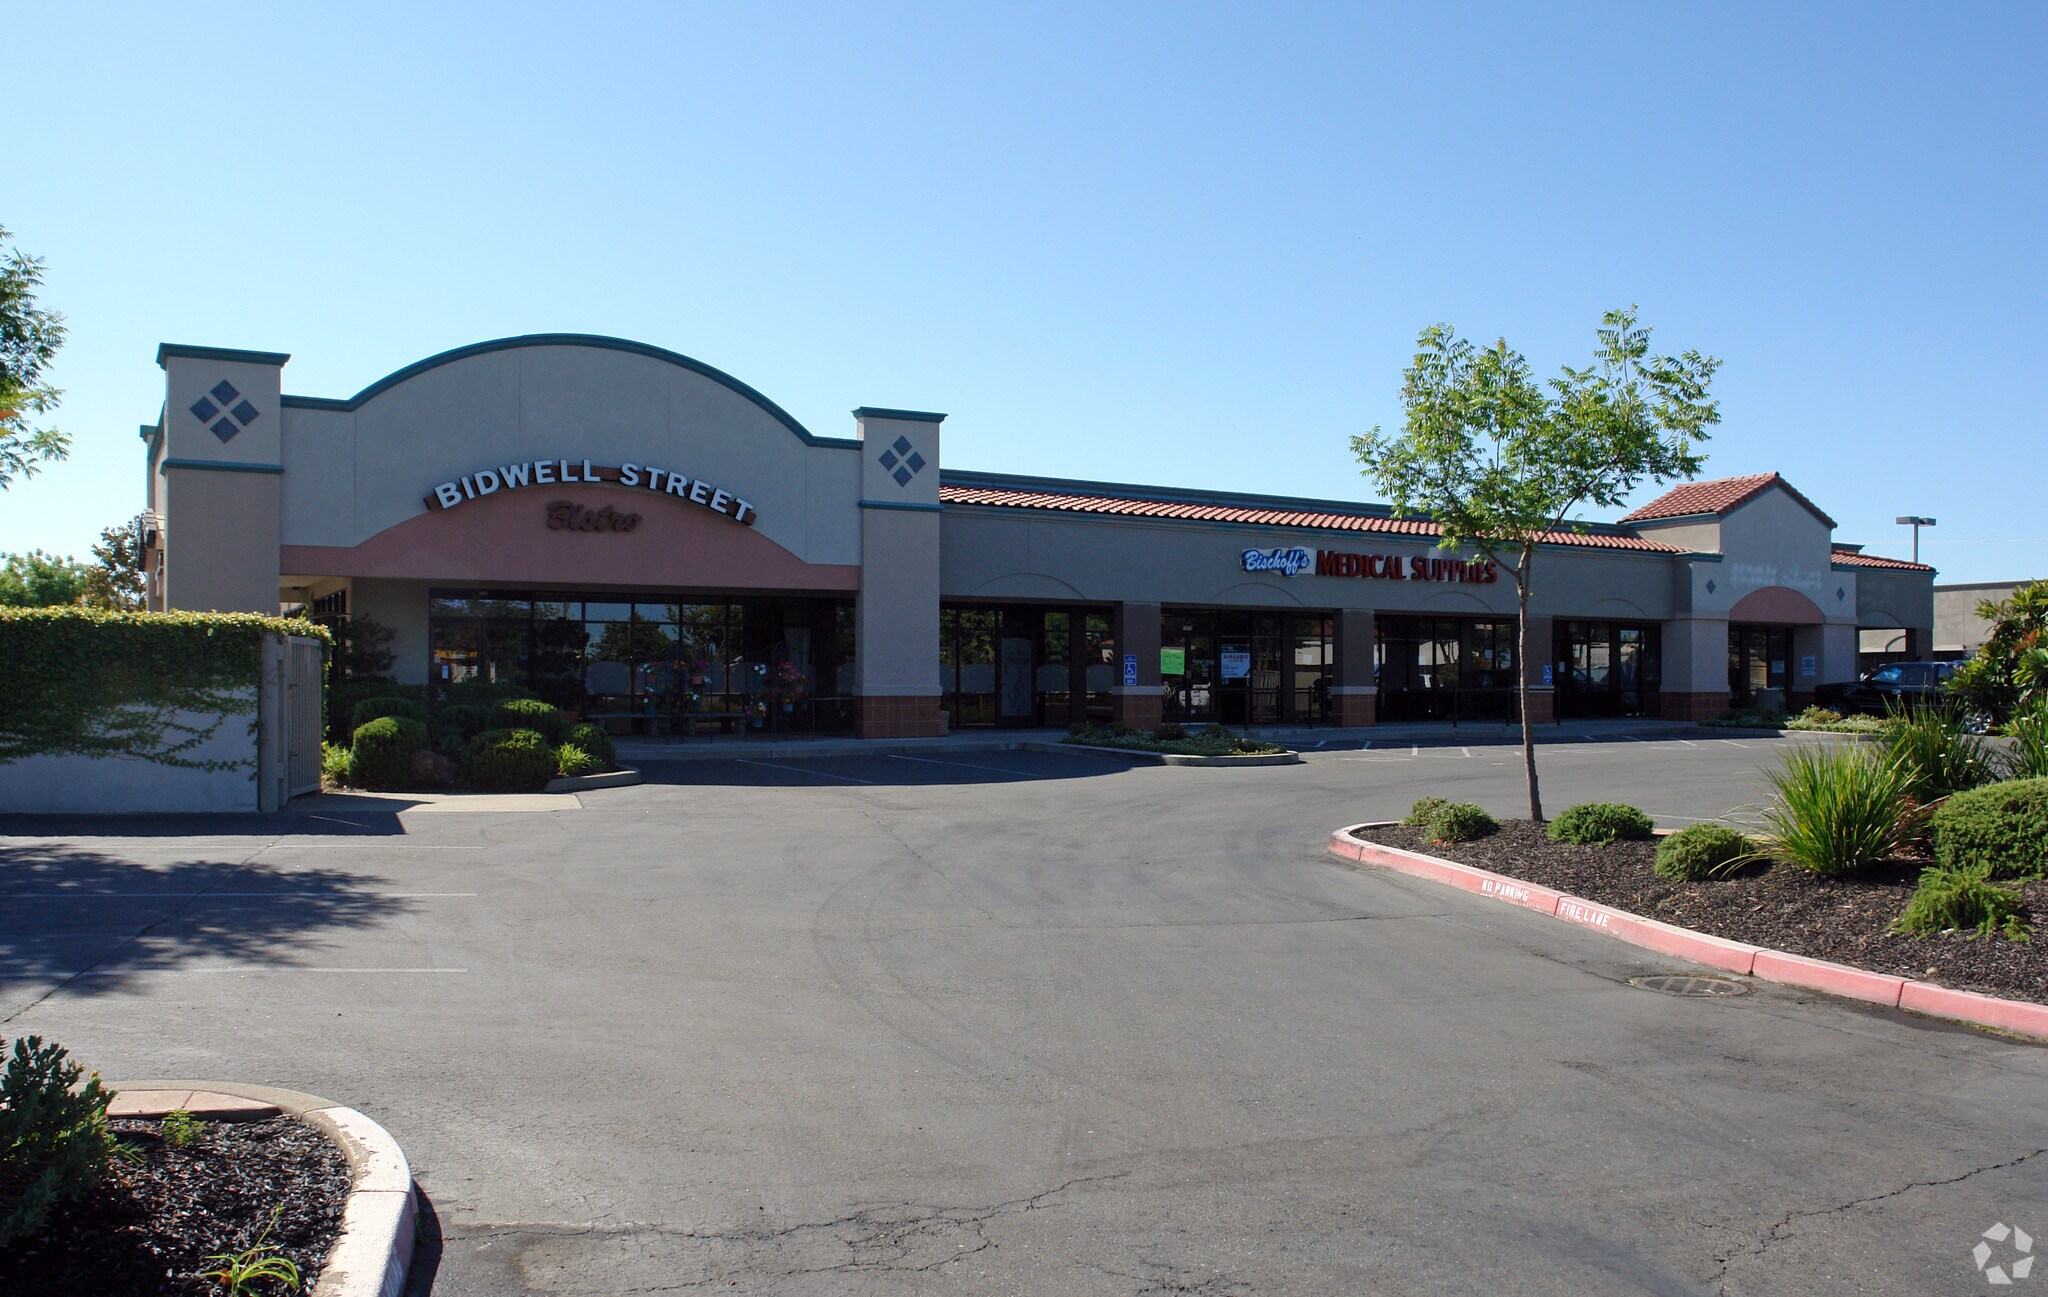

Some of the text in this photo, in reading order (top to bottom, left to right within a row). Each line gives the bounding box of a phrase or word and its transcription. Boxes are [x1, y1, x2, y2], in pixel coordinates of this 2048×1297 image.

[434, 459, 754, 522] BIDWELL STREET
[547, 500, 643, 532] Bistro
[1241, 549, 1498, 584] Bischoff's MEDICAL SUPPLIES
[1482, 879, 1529, 902] NO PARKING
[1560, 902, 1610, 927] FIRE LANE
